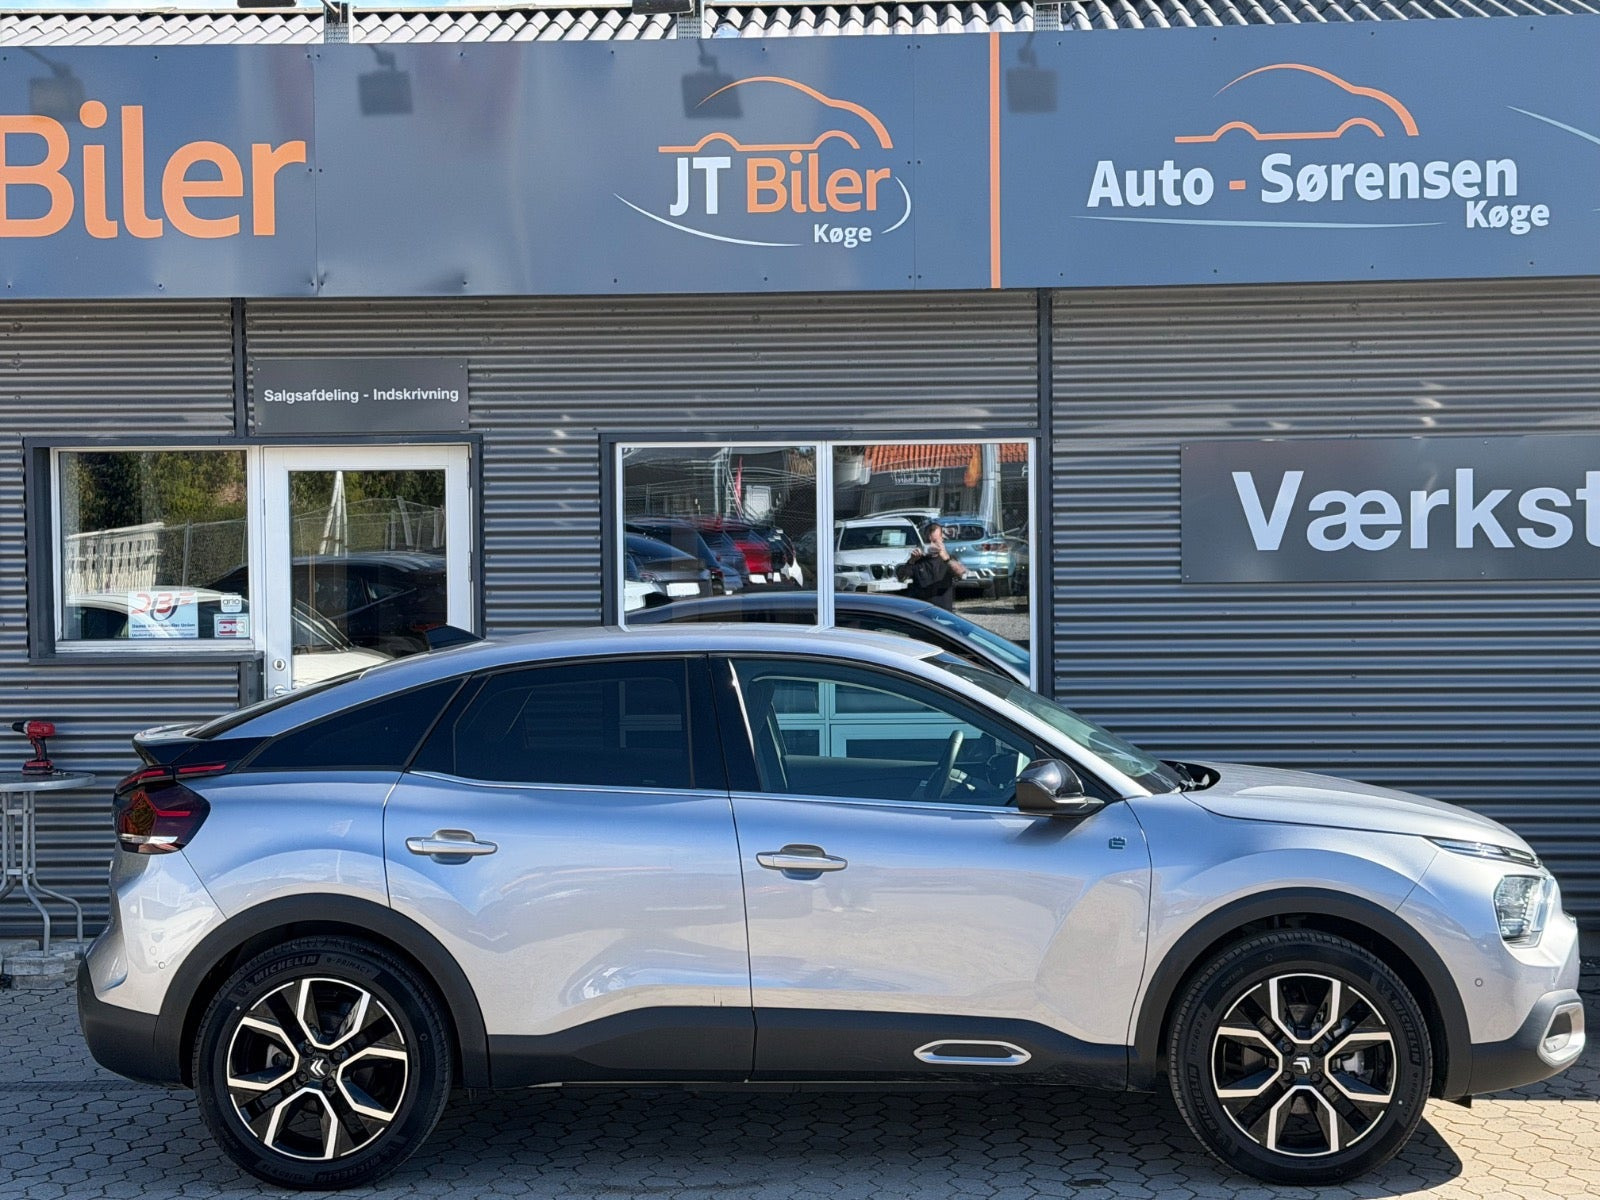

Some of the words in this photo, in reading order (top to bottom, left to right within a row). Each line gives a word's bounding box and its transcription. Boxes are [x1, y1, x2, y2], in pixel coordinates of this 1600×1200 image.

[0, 100, 307, 239] Biler
[670, 157, 730, 216] JT
[747, 151, 890, 213] Biler
[1086, 159, 1214, 208] Auto
[1261, 153, 1517, 202] Sørensen
[813, 222, 873, 250] Køge
[1465, 200, 1550, 236] Køge
[264, 388, 360, 404] Salgsafdeling
[373, 387, 460, 403] Indskrivning
[253, 955, 317, 979] MICHELIN
